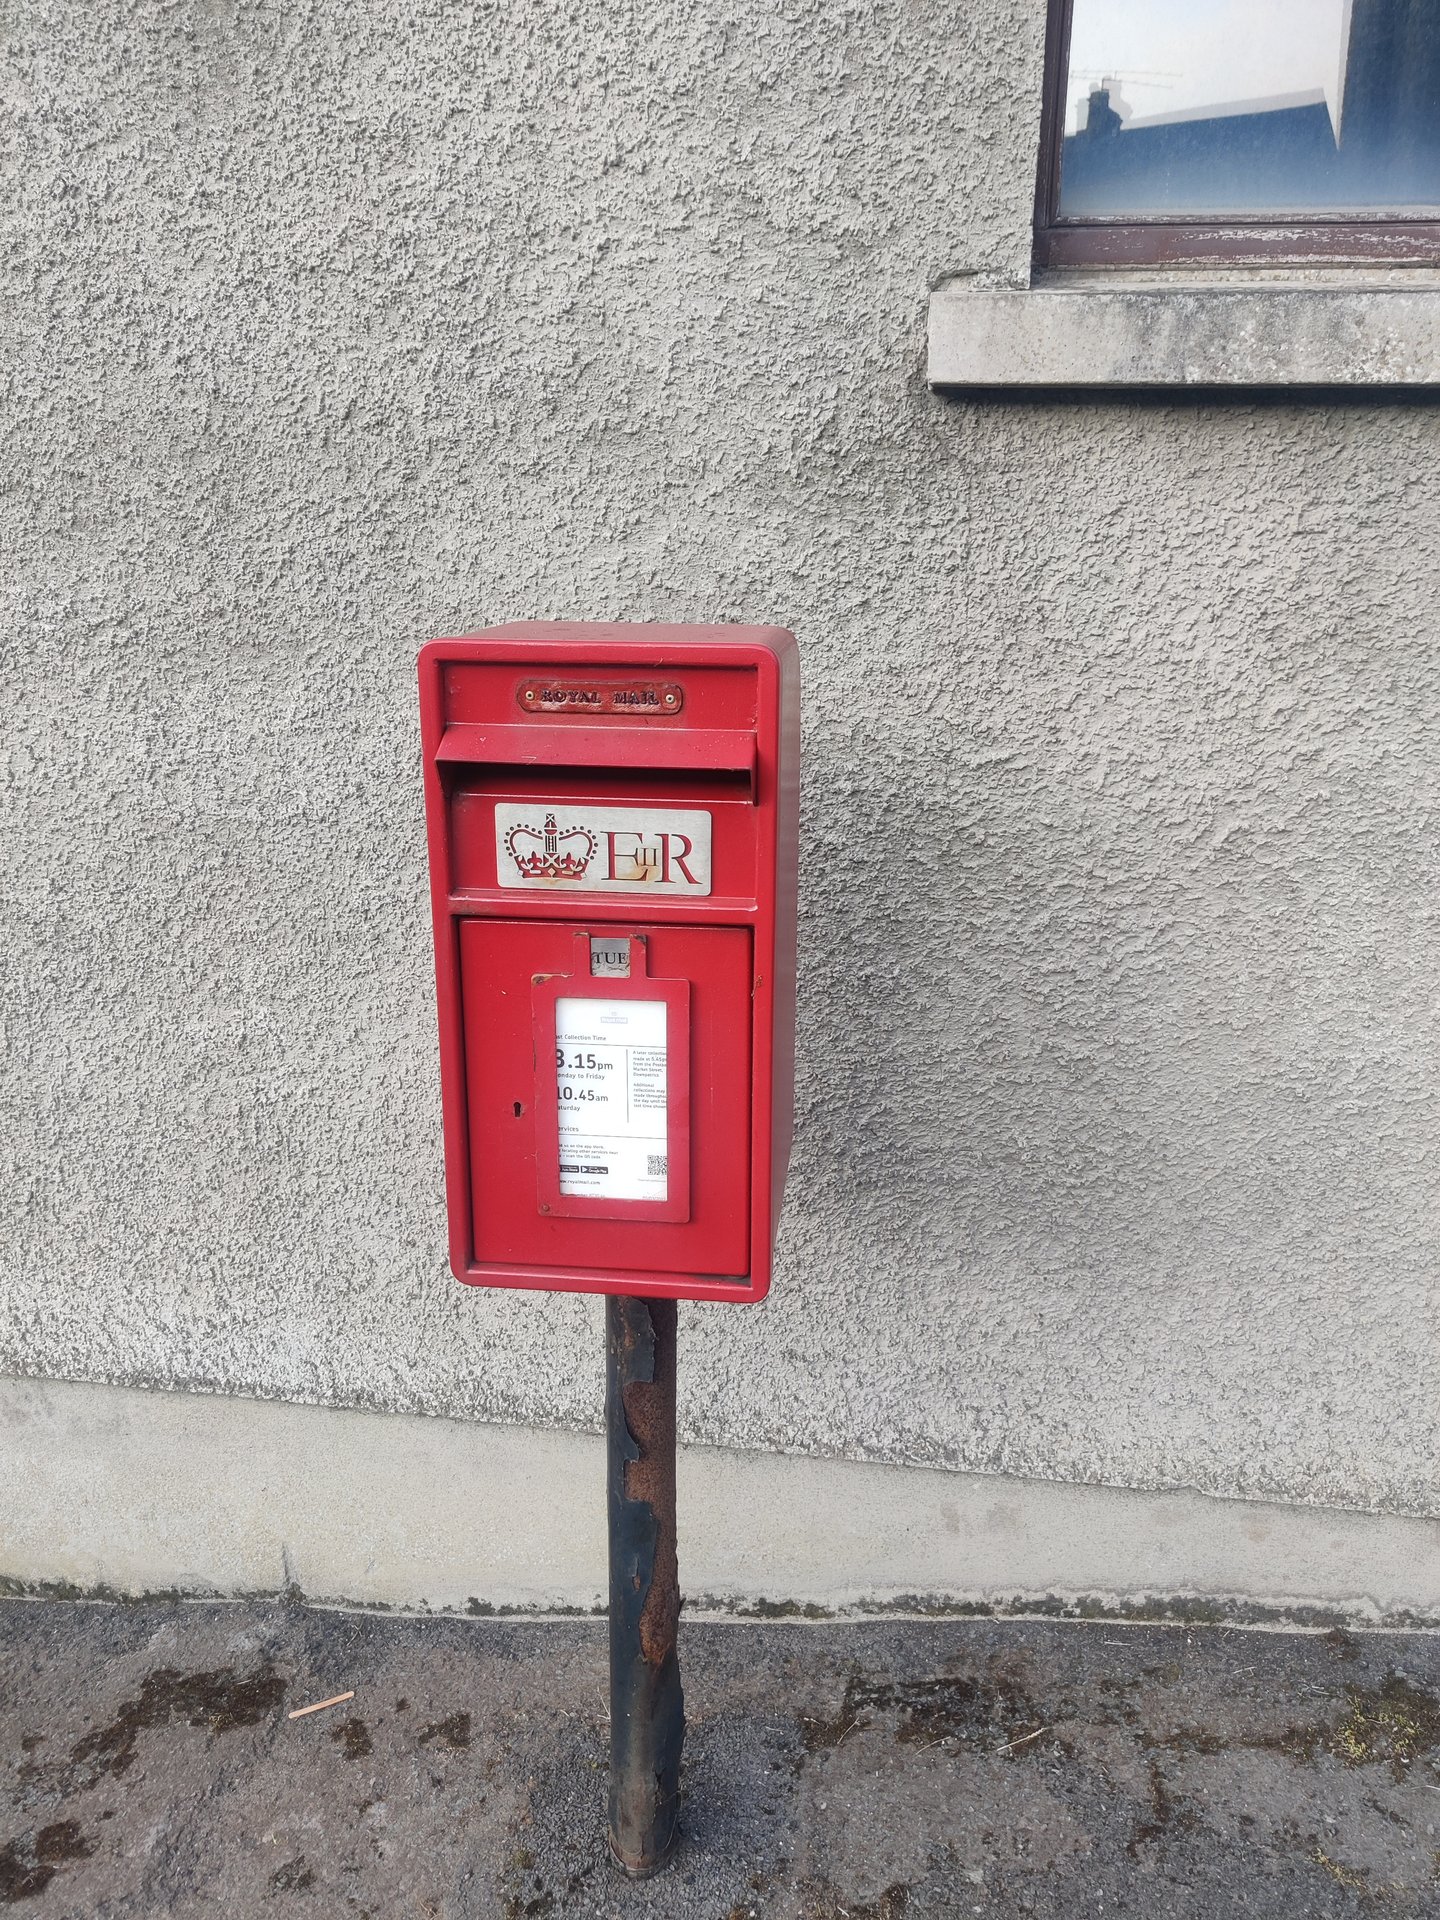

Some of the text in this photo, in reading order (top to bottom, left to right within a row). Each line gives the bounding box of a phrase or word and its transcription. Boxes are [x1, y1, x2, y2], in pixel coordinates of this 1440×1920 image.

[541, 690, 659, 705] ROYAL MAIL
[593, 952, 628, 965] TUE
